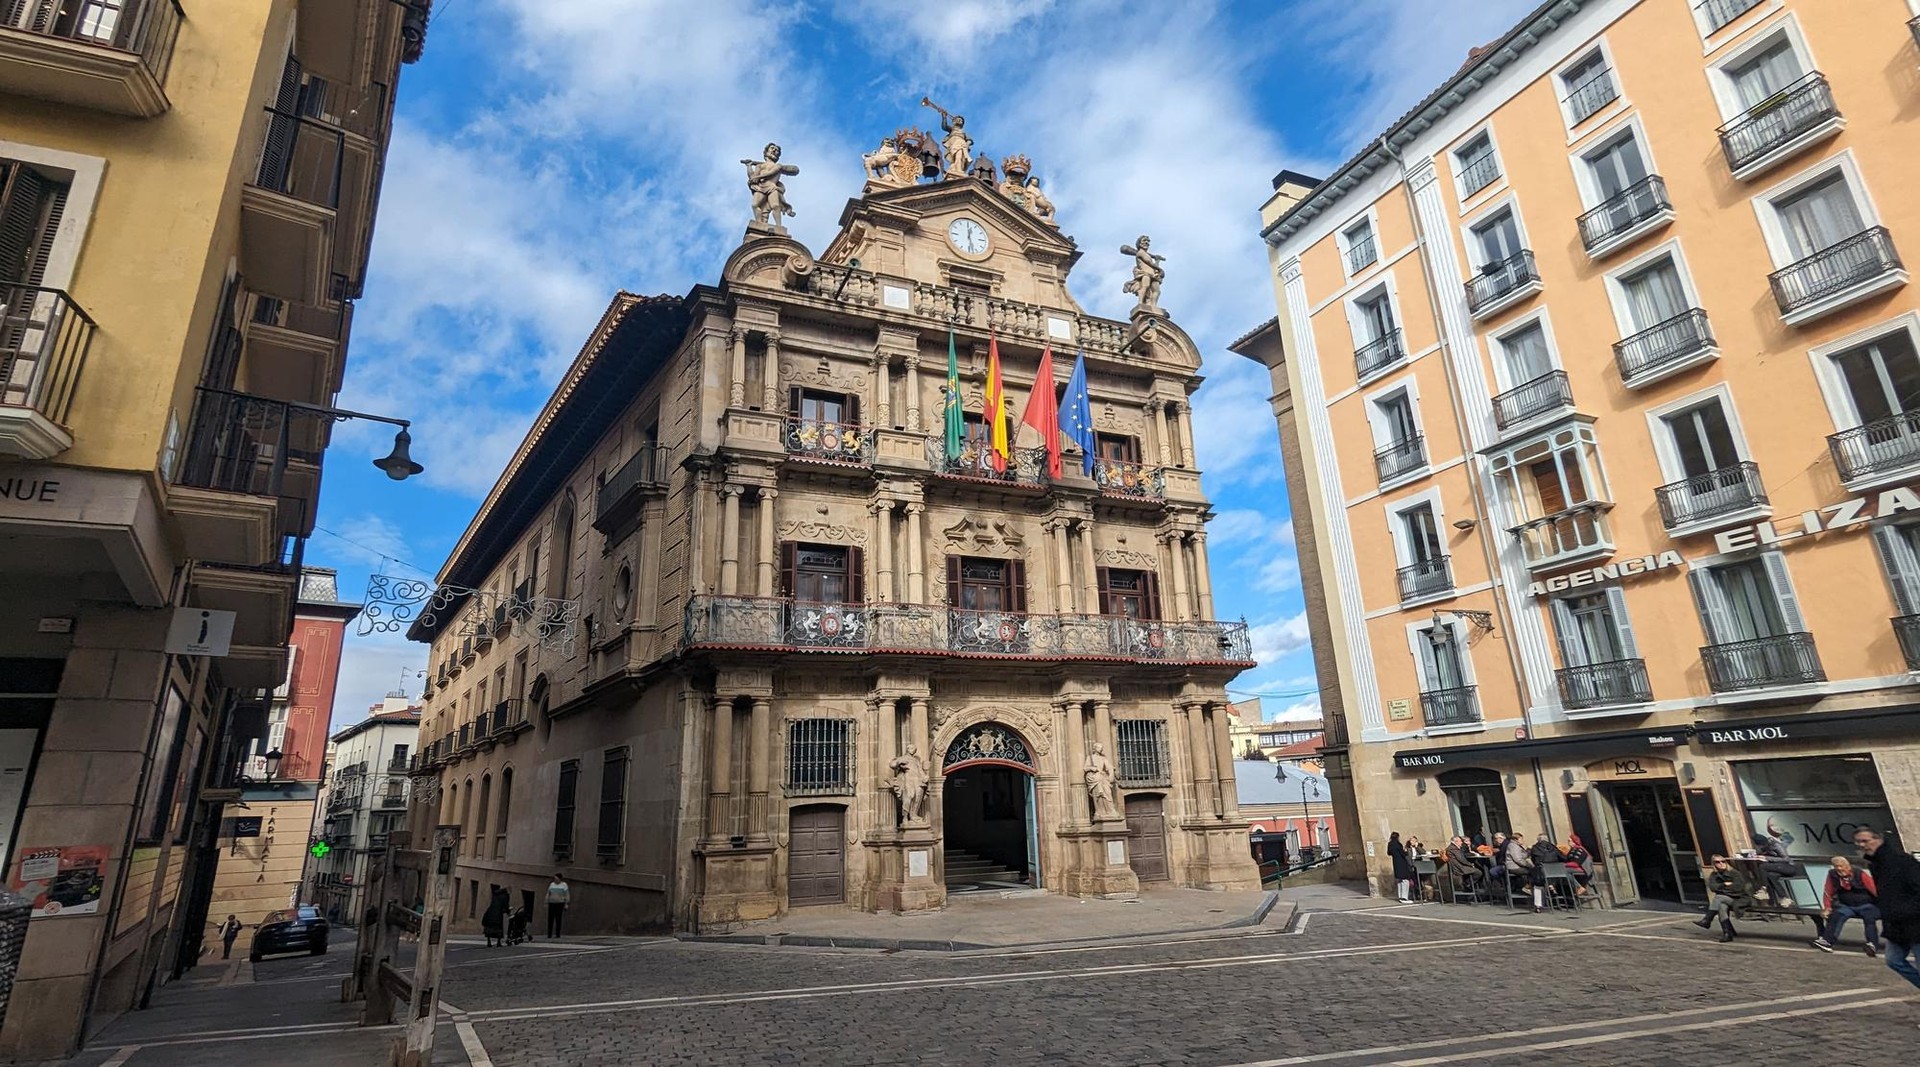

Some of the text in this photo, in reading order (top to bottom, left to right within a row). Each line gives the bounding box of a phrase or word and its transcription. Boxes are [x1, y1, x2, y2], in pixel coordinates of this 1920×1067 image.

[1527, 487, 1920, 597] AGENCIA ELIZA
[1710, 726, 1789, 743] BAR MOL
[1402, 755, 1445, 767] BAR MOL
[1614, 760, 1647, 774] MOL
[1800, 822, 1858, 844] MO
[256, 807, 277, 883] FARMACIA
